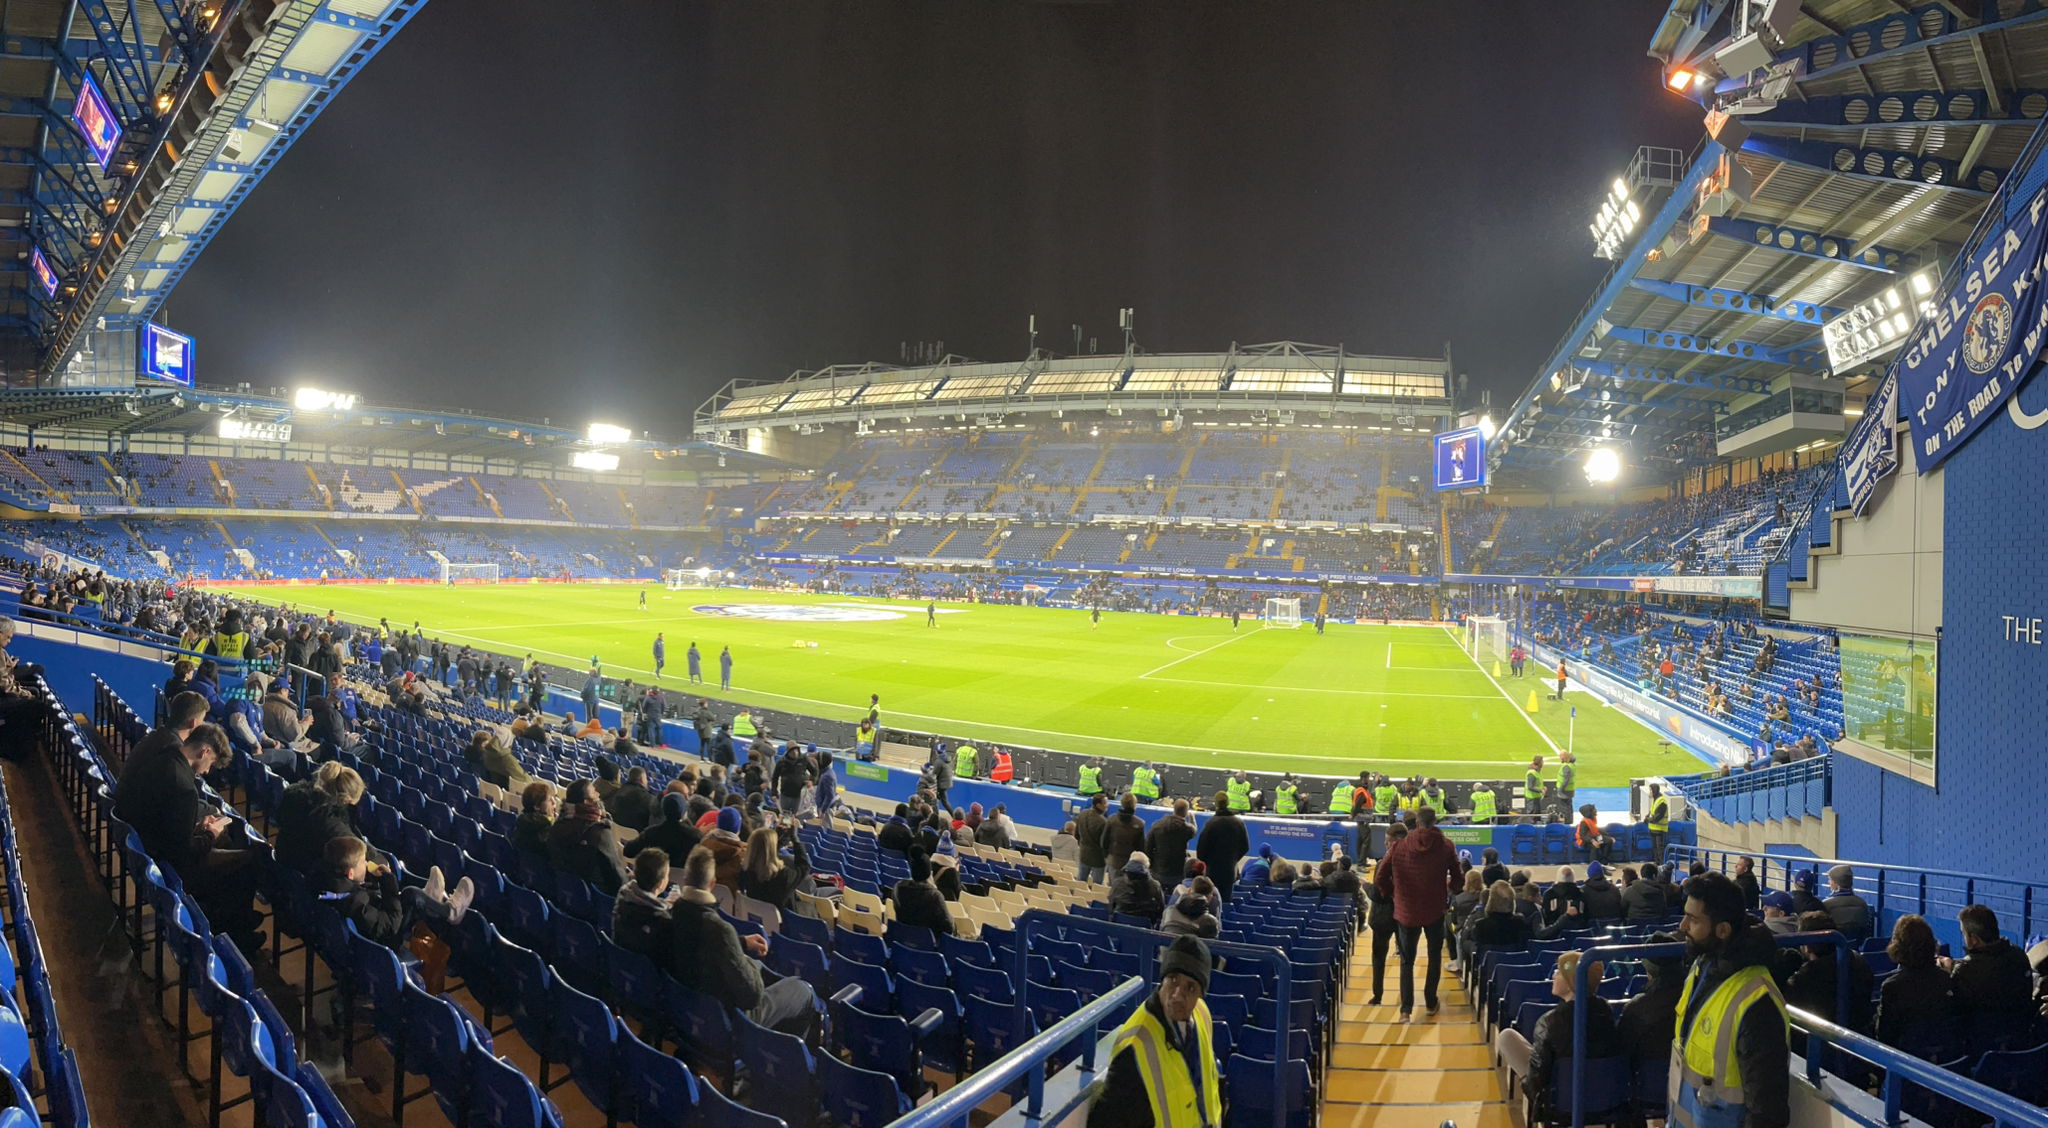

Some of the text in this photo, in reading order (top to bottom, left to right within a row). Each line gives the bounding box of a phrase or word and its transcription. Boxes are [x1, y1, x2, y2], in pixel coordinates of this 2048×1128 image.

[1905, 229, 2021, 369] CHELSEA
[1917, 348, 1957, 425] TONY
[1925, 432, 1940, 456] ON
[1943, 410, 1966, 441] THE
[1967, 377, 2001, 419] ROAD
[2002, 354, 2023, 381] TO
[2002, 616, 2042, 645] THE
[1690, 725, 1730, 760] Introducing
